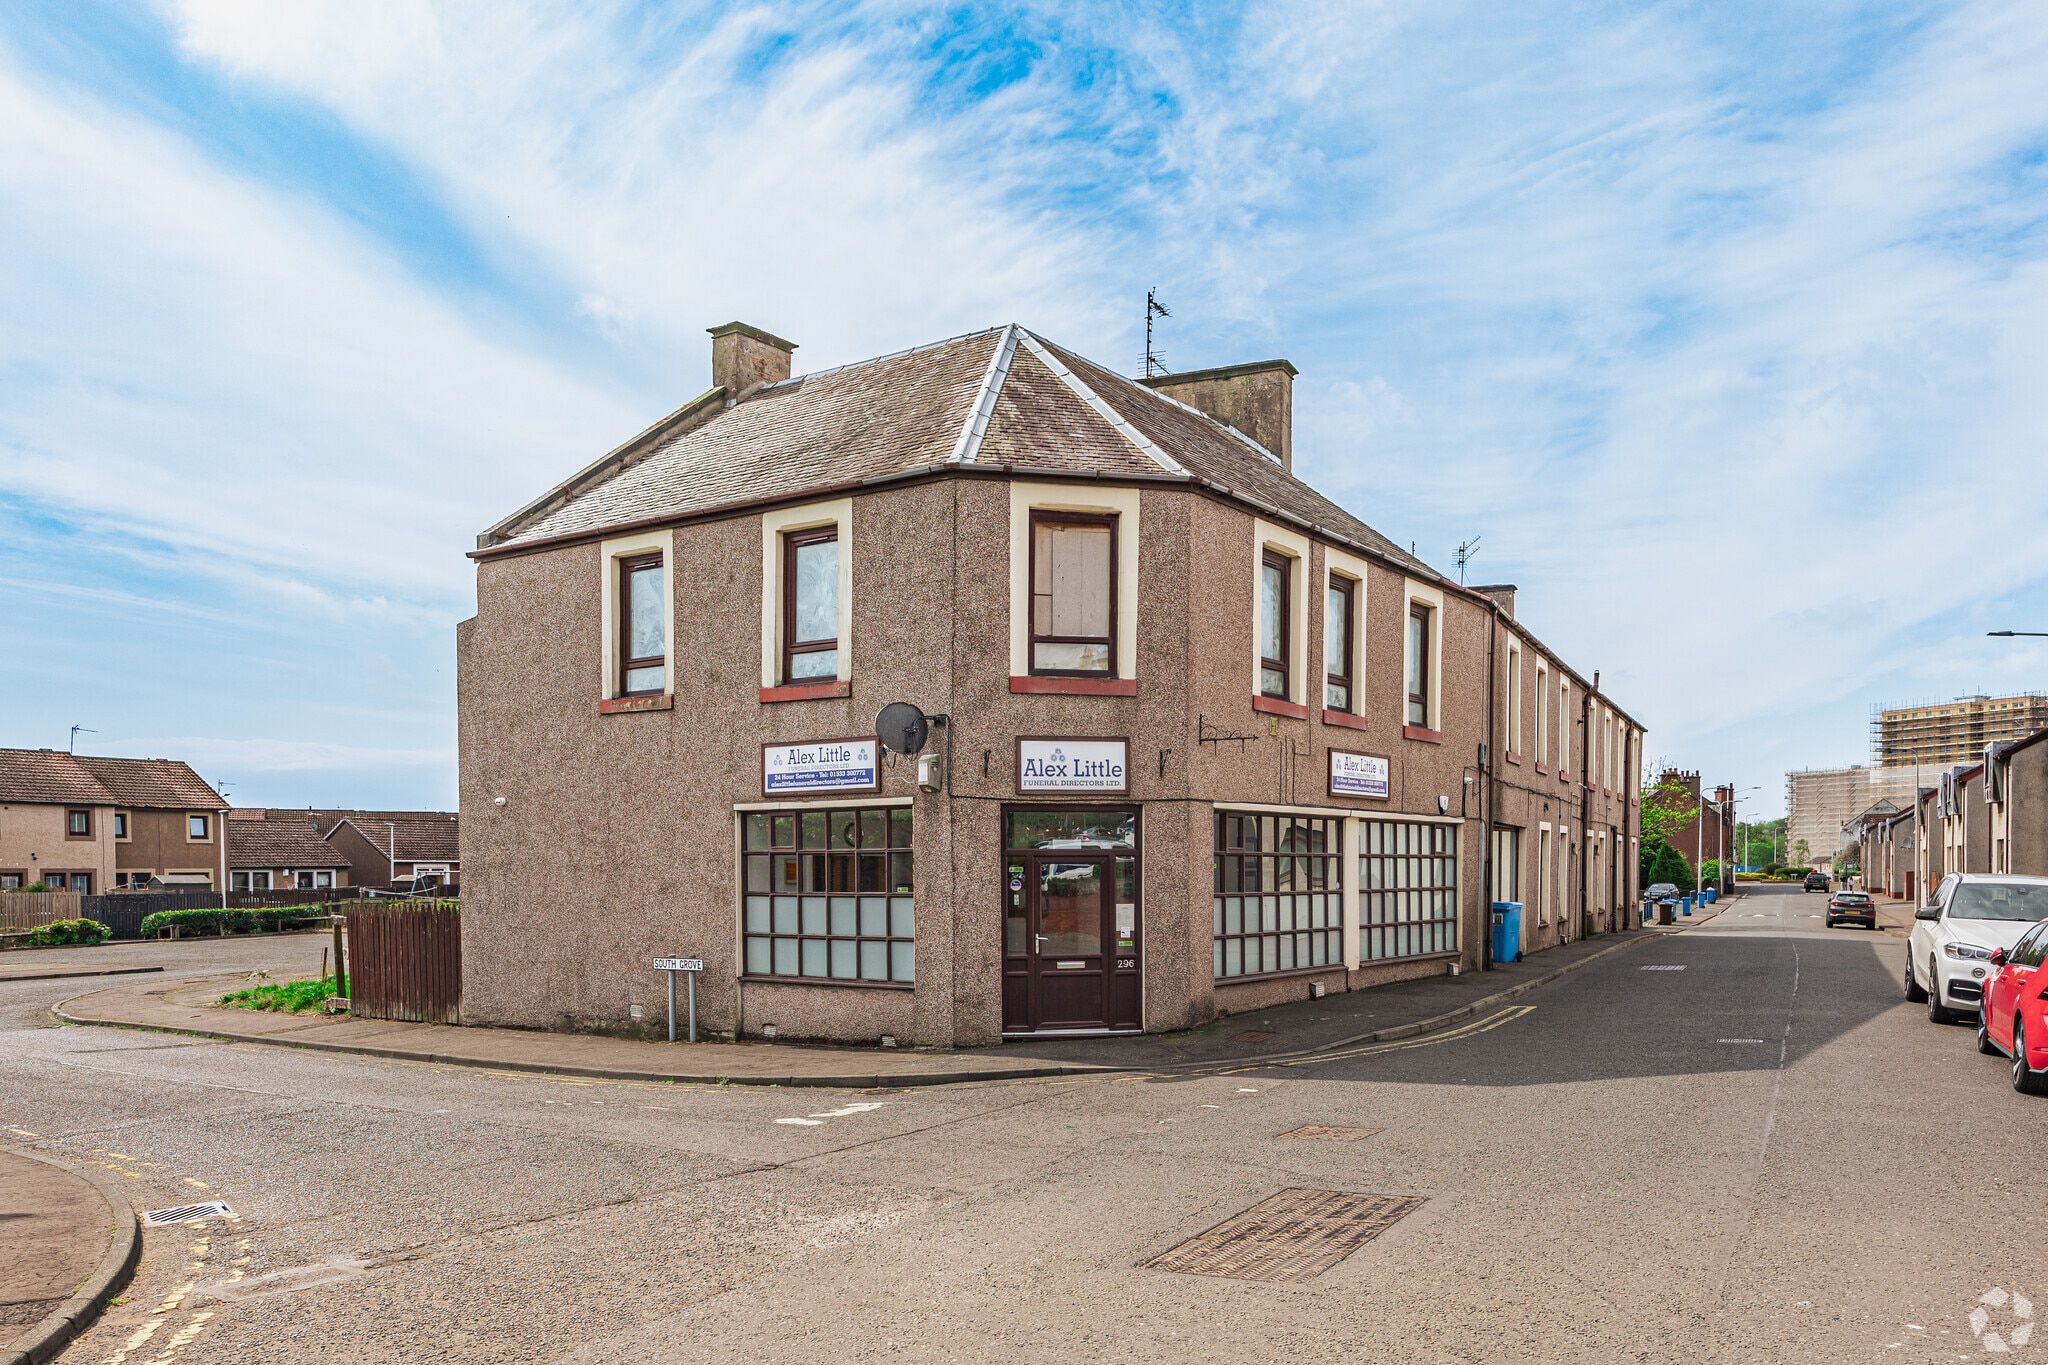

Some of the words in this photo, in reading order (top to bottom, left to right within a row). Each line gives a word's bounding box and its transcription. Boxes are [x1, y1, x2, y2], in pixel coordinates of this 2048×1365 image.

[788, 749, 815, 765] Alex
[818, 746, 851, 763] Little
[1023, 758, 1067, 777] Alex
[1073, 759, 1122, 777] Little
[1344, 756, 1359, 771] Alex
[1360, 758, 1376, 773] Little
[654, 959, 677, 968] SOUTH
[679, 959, 702, 970] GROVE
[1117, 959, 1135, 968] 296
